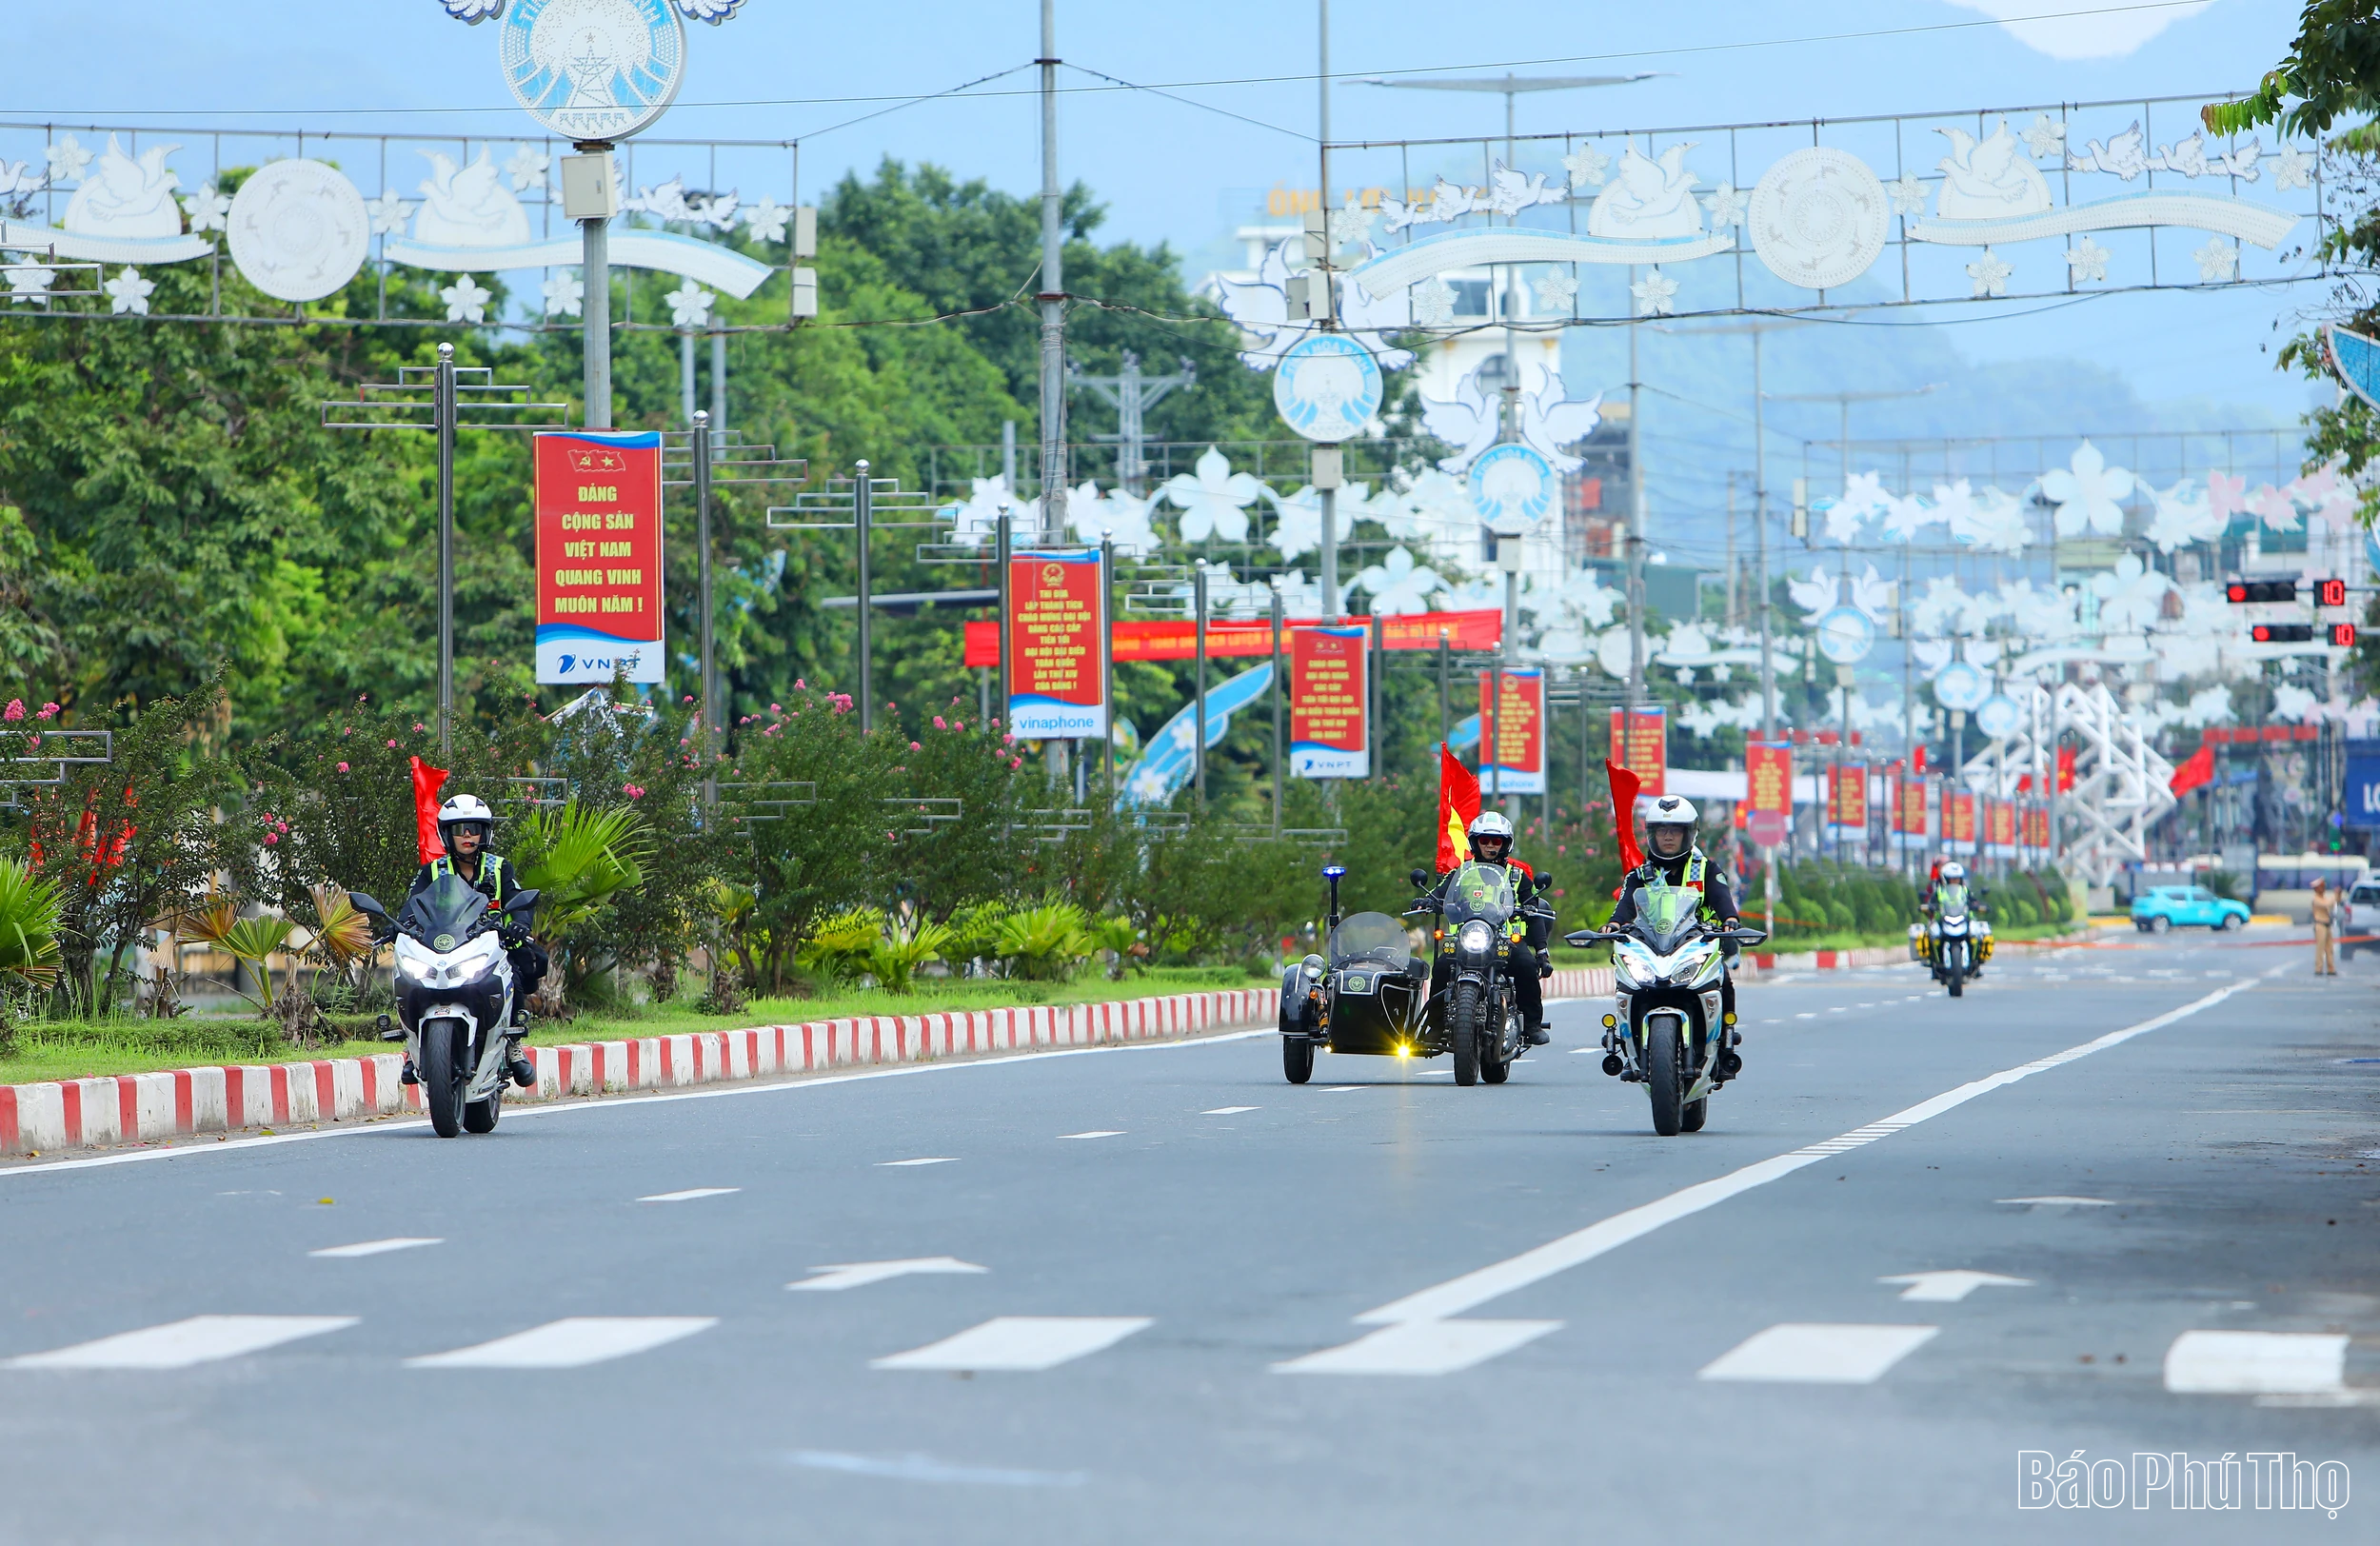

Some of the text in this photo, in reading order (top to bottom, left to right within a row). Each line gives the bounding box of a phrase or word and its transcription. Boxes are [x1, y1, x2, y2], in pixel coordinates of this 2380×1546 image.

[578, 483, 617, 502] ĐẢNG
[562, 510, 634, 532] CỘNG SẢN
[565, 540, 631, 560] VIỆT NAM
[555, 569, 641, 586] QUANG VINH
[2323, 580, 2344, 605] 10
[555, 595, 597, 613] MUÔN
[602, 595, 633, 612] NĂM
[2335, 624, 2354, 646] 10
[1020, 716, 1094, 730] vinaphone
